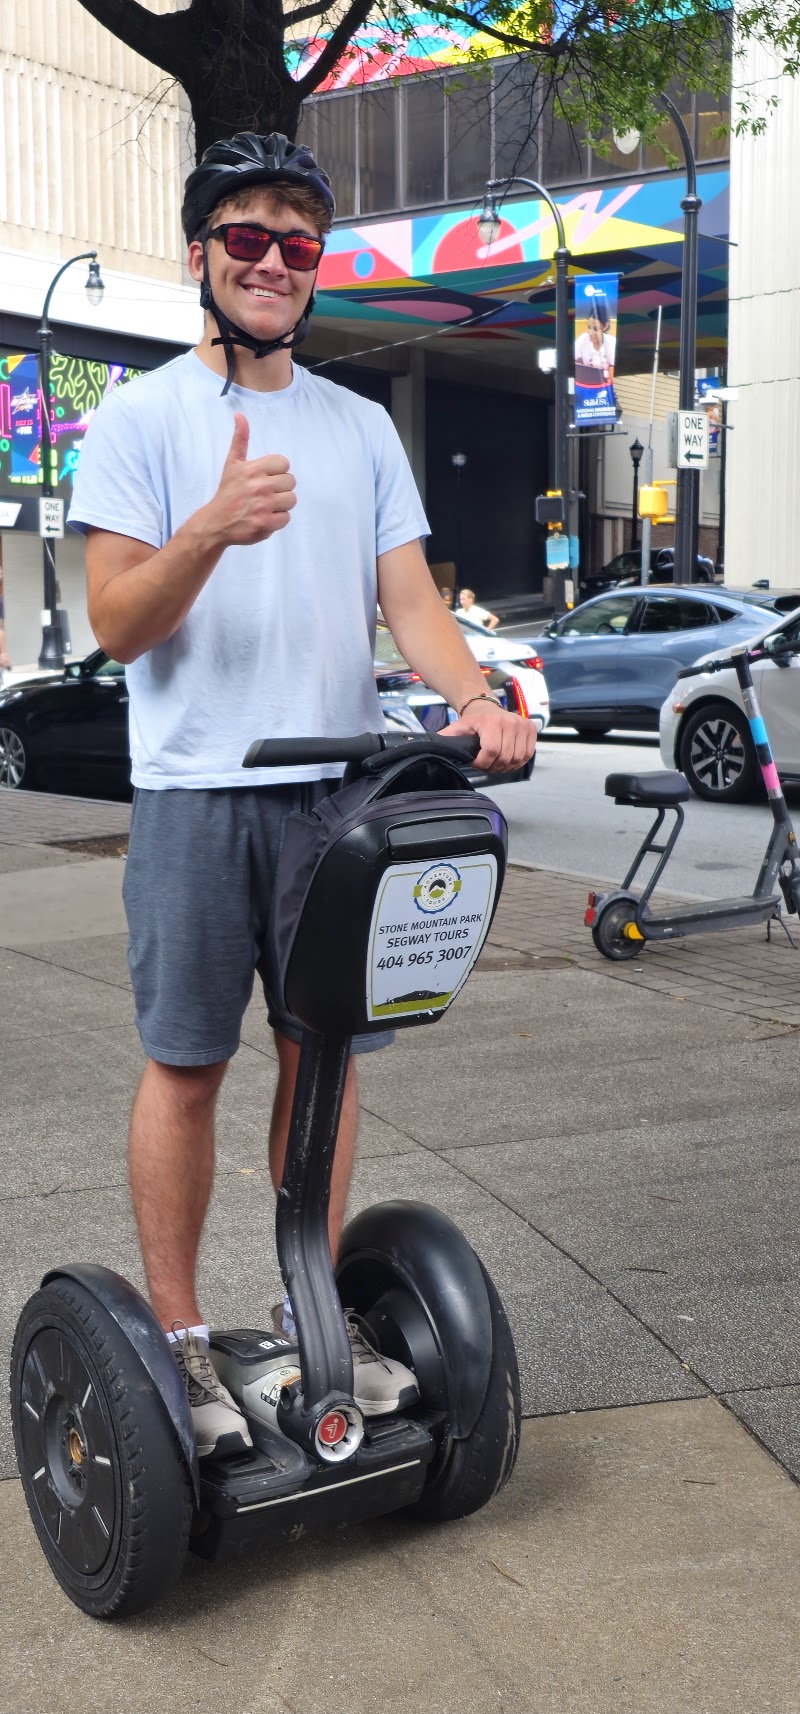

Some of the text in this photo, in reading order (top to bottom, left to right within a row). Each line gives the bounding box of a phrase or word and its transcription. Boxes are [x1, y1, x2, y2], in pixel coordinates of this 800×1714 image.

[684, 417, 704, 430] ONE
[684, 434, 704, 447] WAY
[45, 502, 60, 511] ONE
[45, 514, 60, 523] WAY
[424, 872, 453, 889] ADVENTURE
[378, 913, 483, 935] STONE MOUNTAIN PARK
[386, 928, 470, 949] SEGWAY TOURS
[376, 945, 472, 970] 404 965 3007
